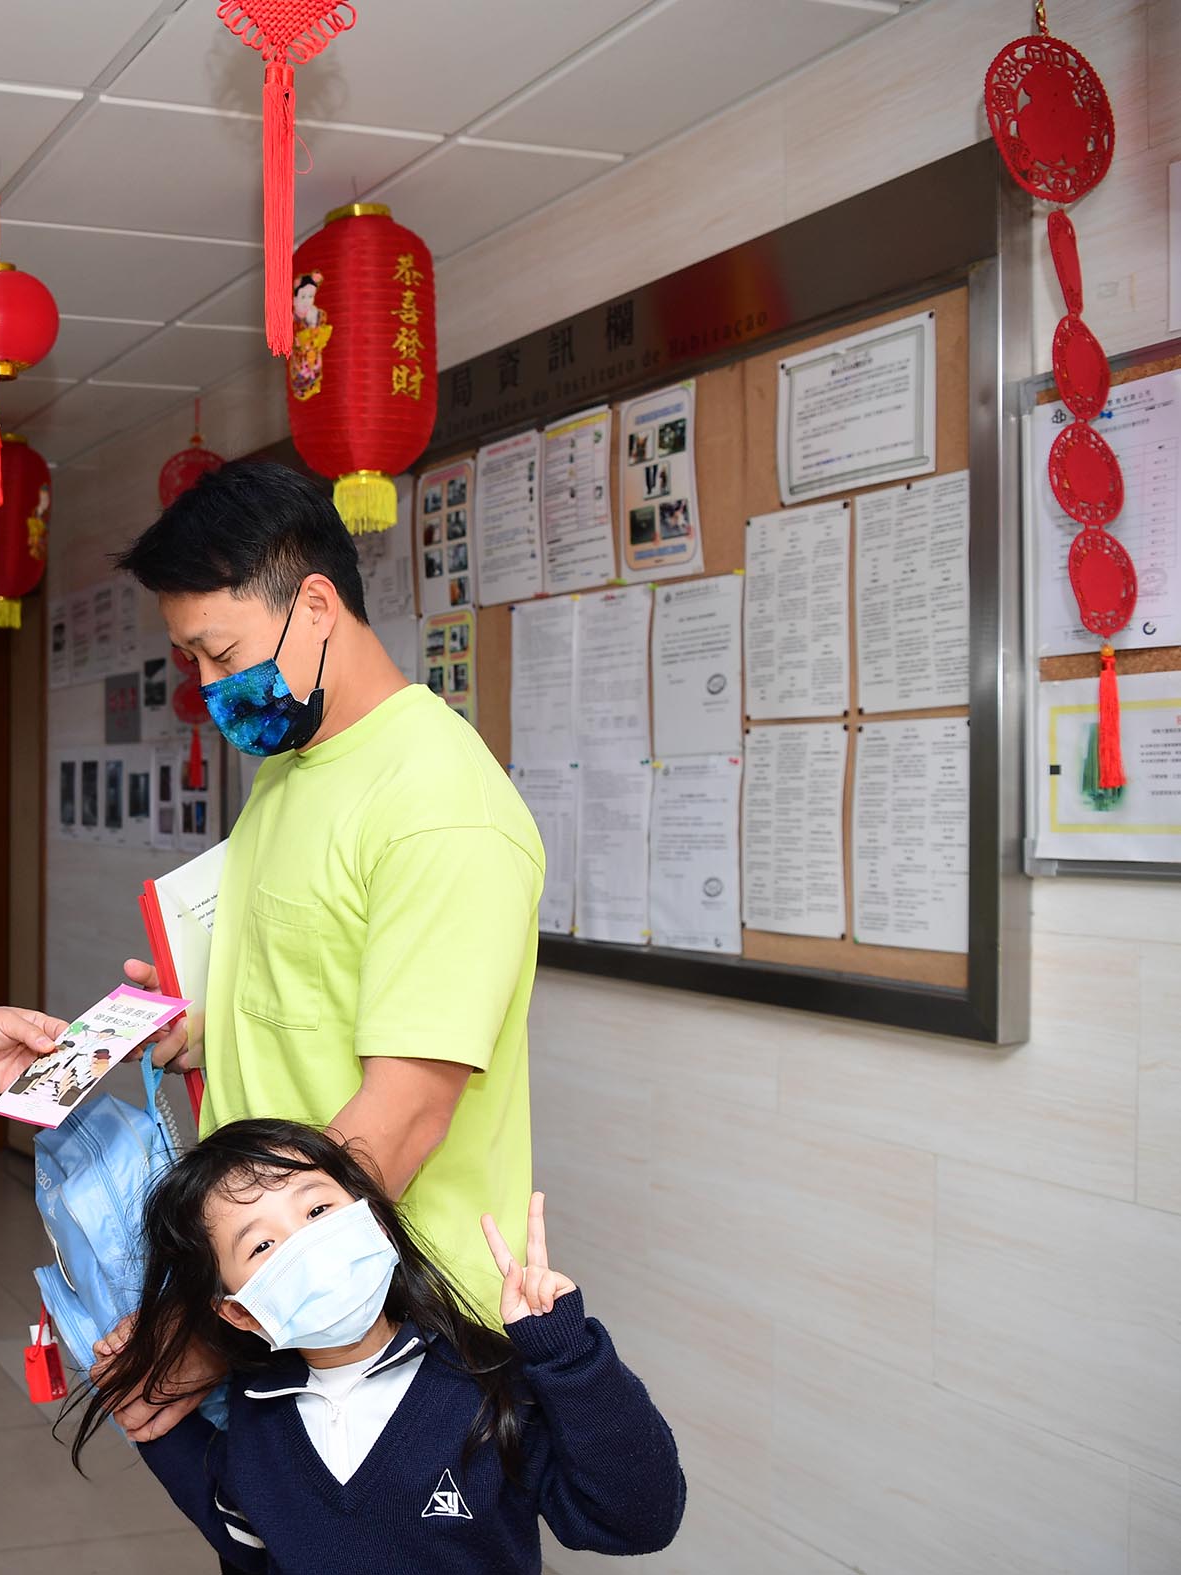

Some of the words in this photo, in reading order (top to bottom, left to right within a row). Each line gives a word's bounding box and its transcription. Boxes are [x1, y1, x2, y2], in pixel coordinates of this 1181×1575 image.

[390, 253, 425, 400] 恭喜發財
[669, 311, 768, 356] Habitação
